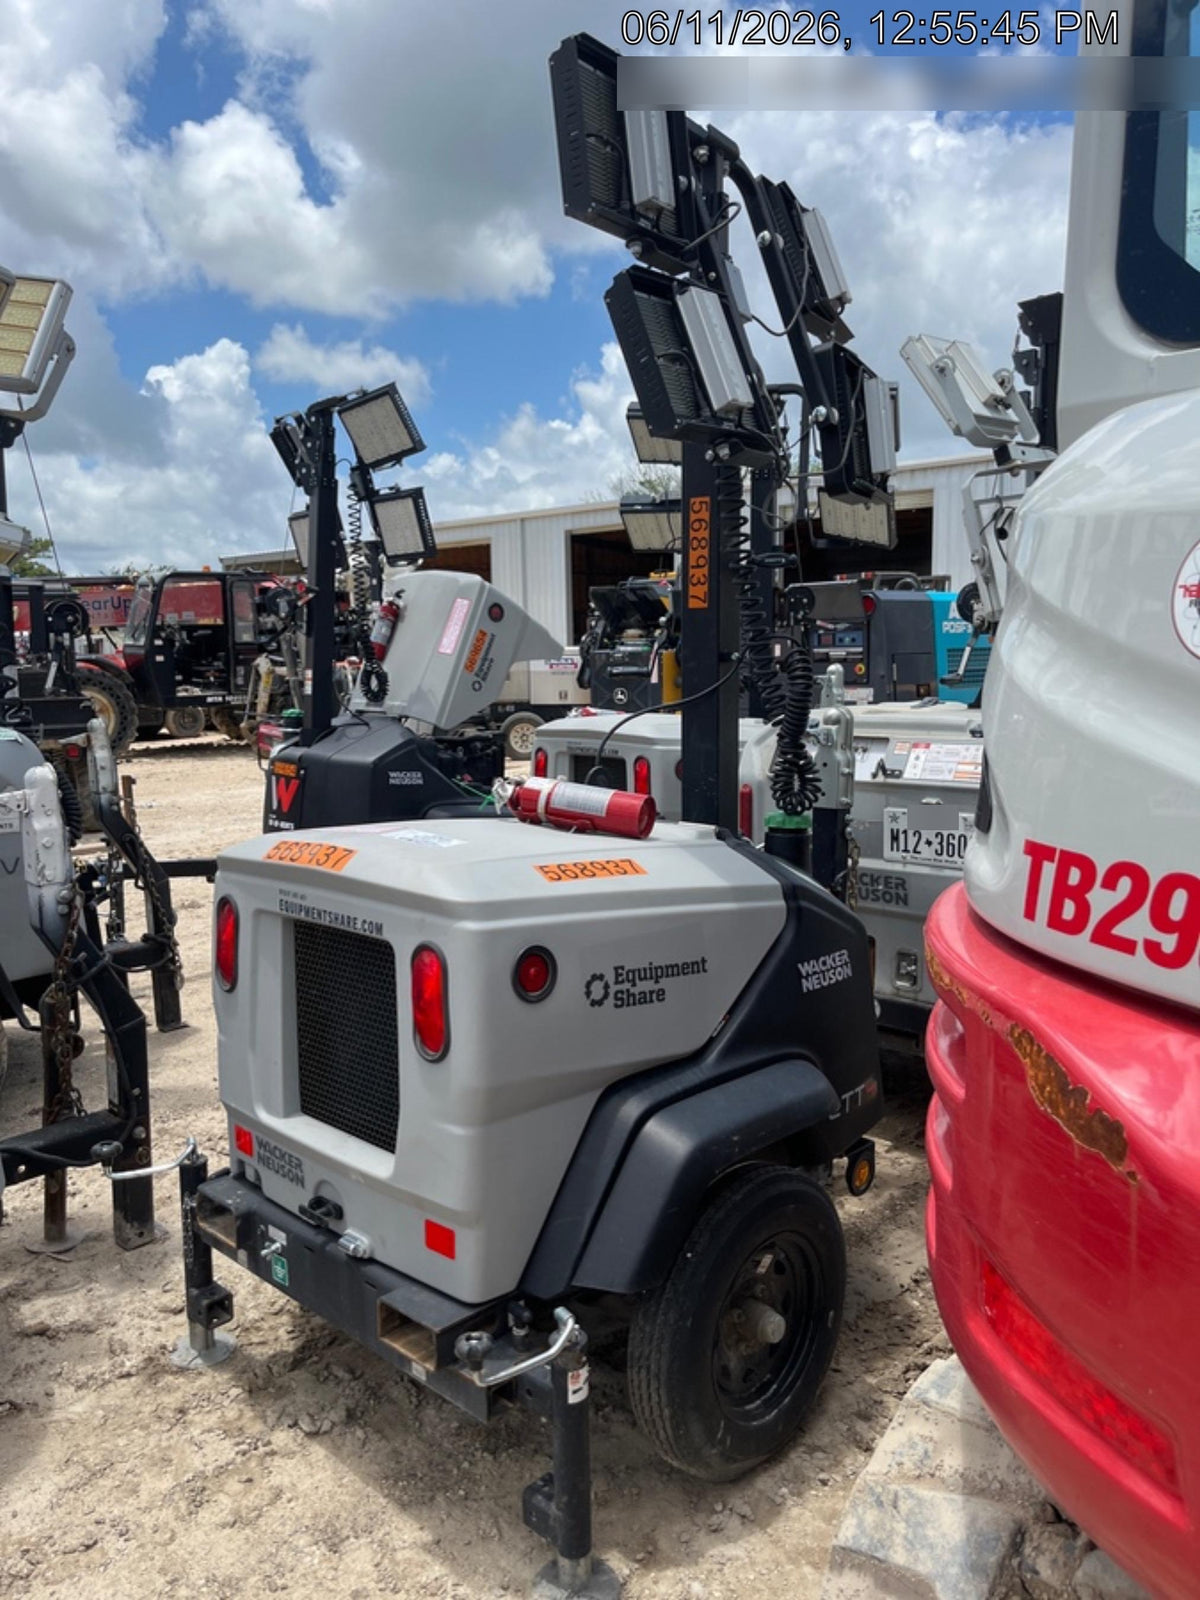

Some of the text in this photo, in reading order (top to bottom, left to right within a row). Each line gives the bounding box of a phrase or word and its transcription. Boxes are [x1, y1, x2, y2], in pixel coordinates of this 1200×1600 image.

[690, 500, 708, 604] 568937
[81, 596, 132, 617] earUp
[266, 841, 354, 869] 568937
[934, 831, 973, 860] 360
[540, 859, 640, 882] 568937
[858, 872, 907, 891] CKER
[857, 886, 909, 906] USON
[1023, 838, 1200, 970] TB29
[279, 899, 384, 936] EQUIPMENTSHARE.COM
[613, 956, 708, 987] Equipment
[797, 949, 850, 977] WACKER
[801, 963, 853, 993] NEUSON
[613, 988, 666, 1009] Share
[255, 1135, 303, 1170] WACKER
[256, 1150, 305, 1190] NEUSON
